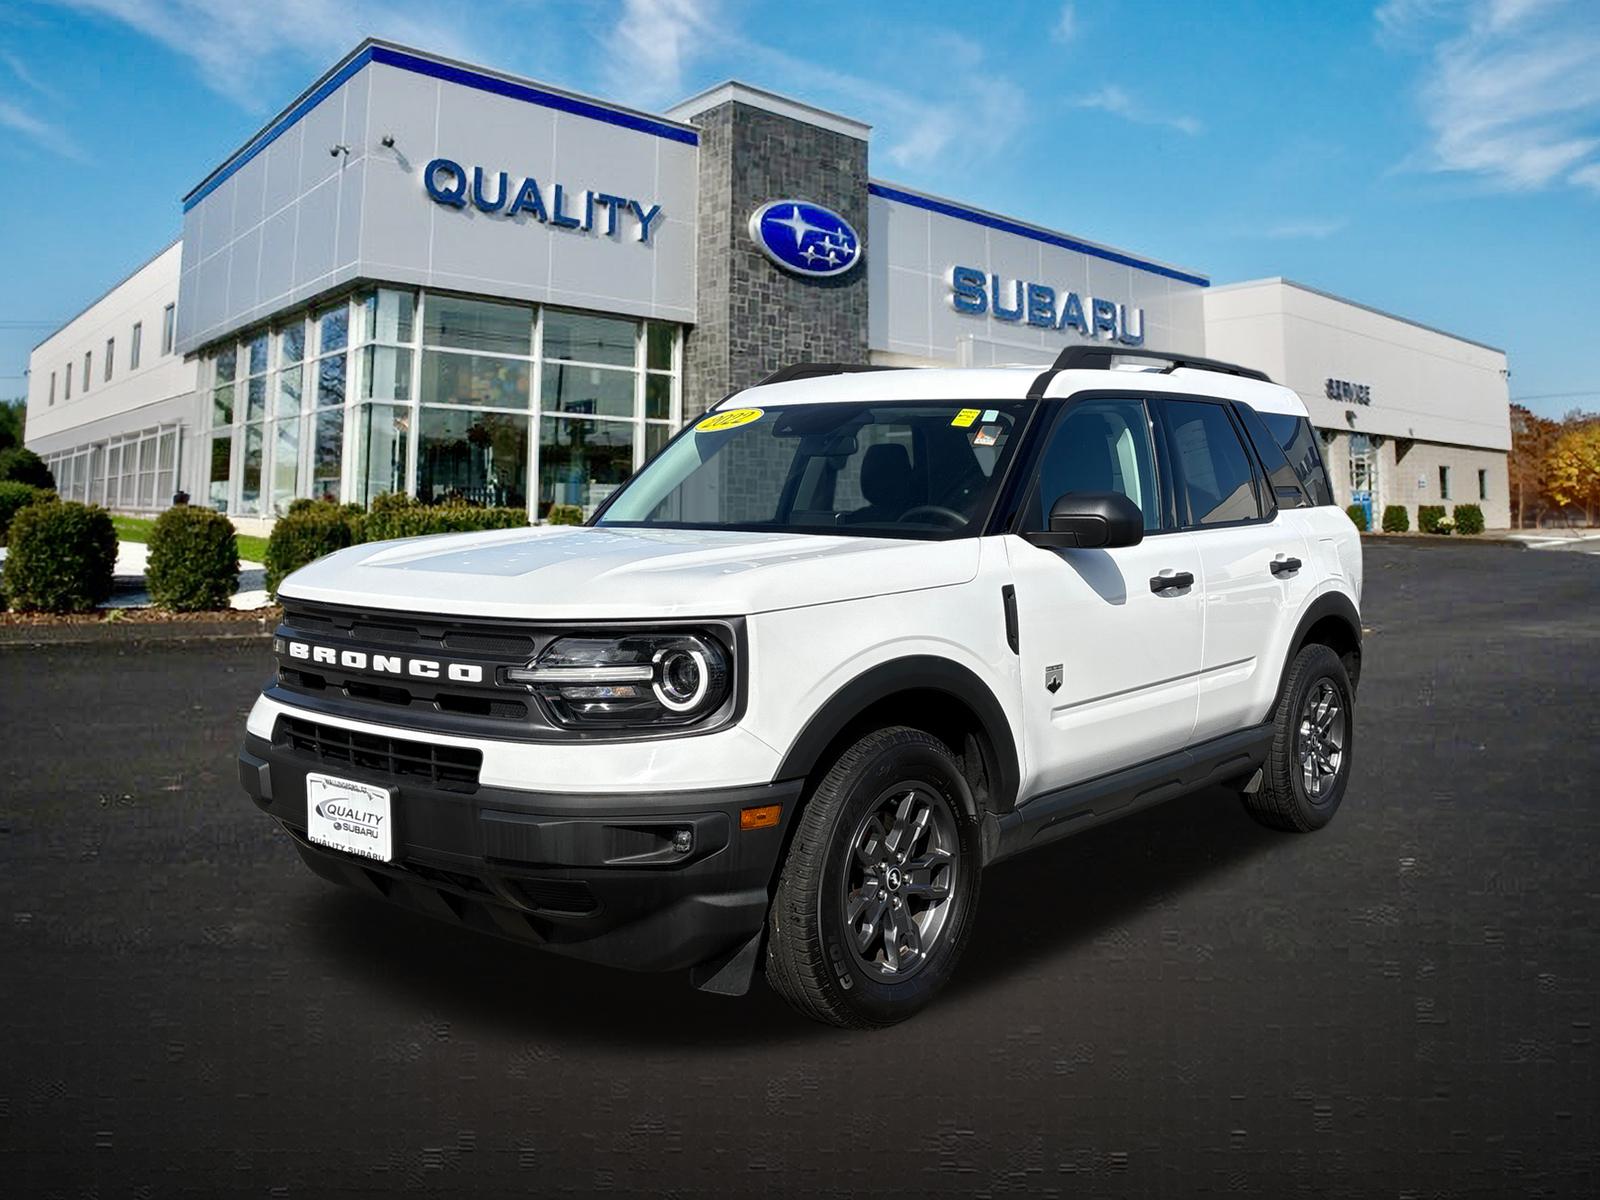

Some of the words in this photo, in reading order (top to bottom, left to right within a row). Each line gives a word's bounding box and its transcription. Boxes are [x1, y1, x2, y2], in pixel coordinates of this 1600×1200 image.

[424, 158, 661, 242] QUALITY
[952, 265, 1145, 346] SUBARU
[1325, 378, 1371, 407] SERVICE
[702, 411, 756, 428] 2022
[289, 641, 483, 683] BRONCO
[327, 804, 383, 825] QUALITY
[342, 822, 378, 838] SUBARU
[310, 836, 345, 851] QUALITY
[347, 846, 384, 860] SUBARU
